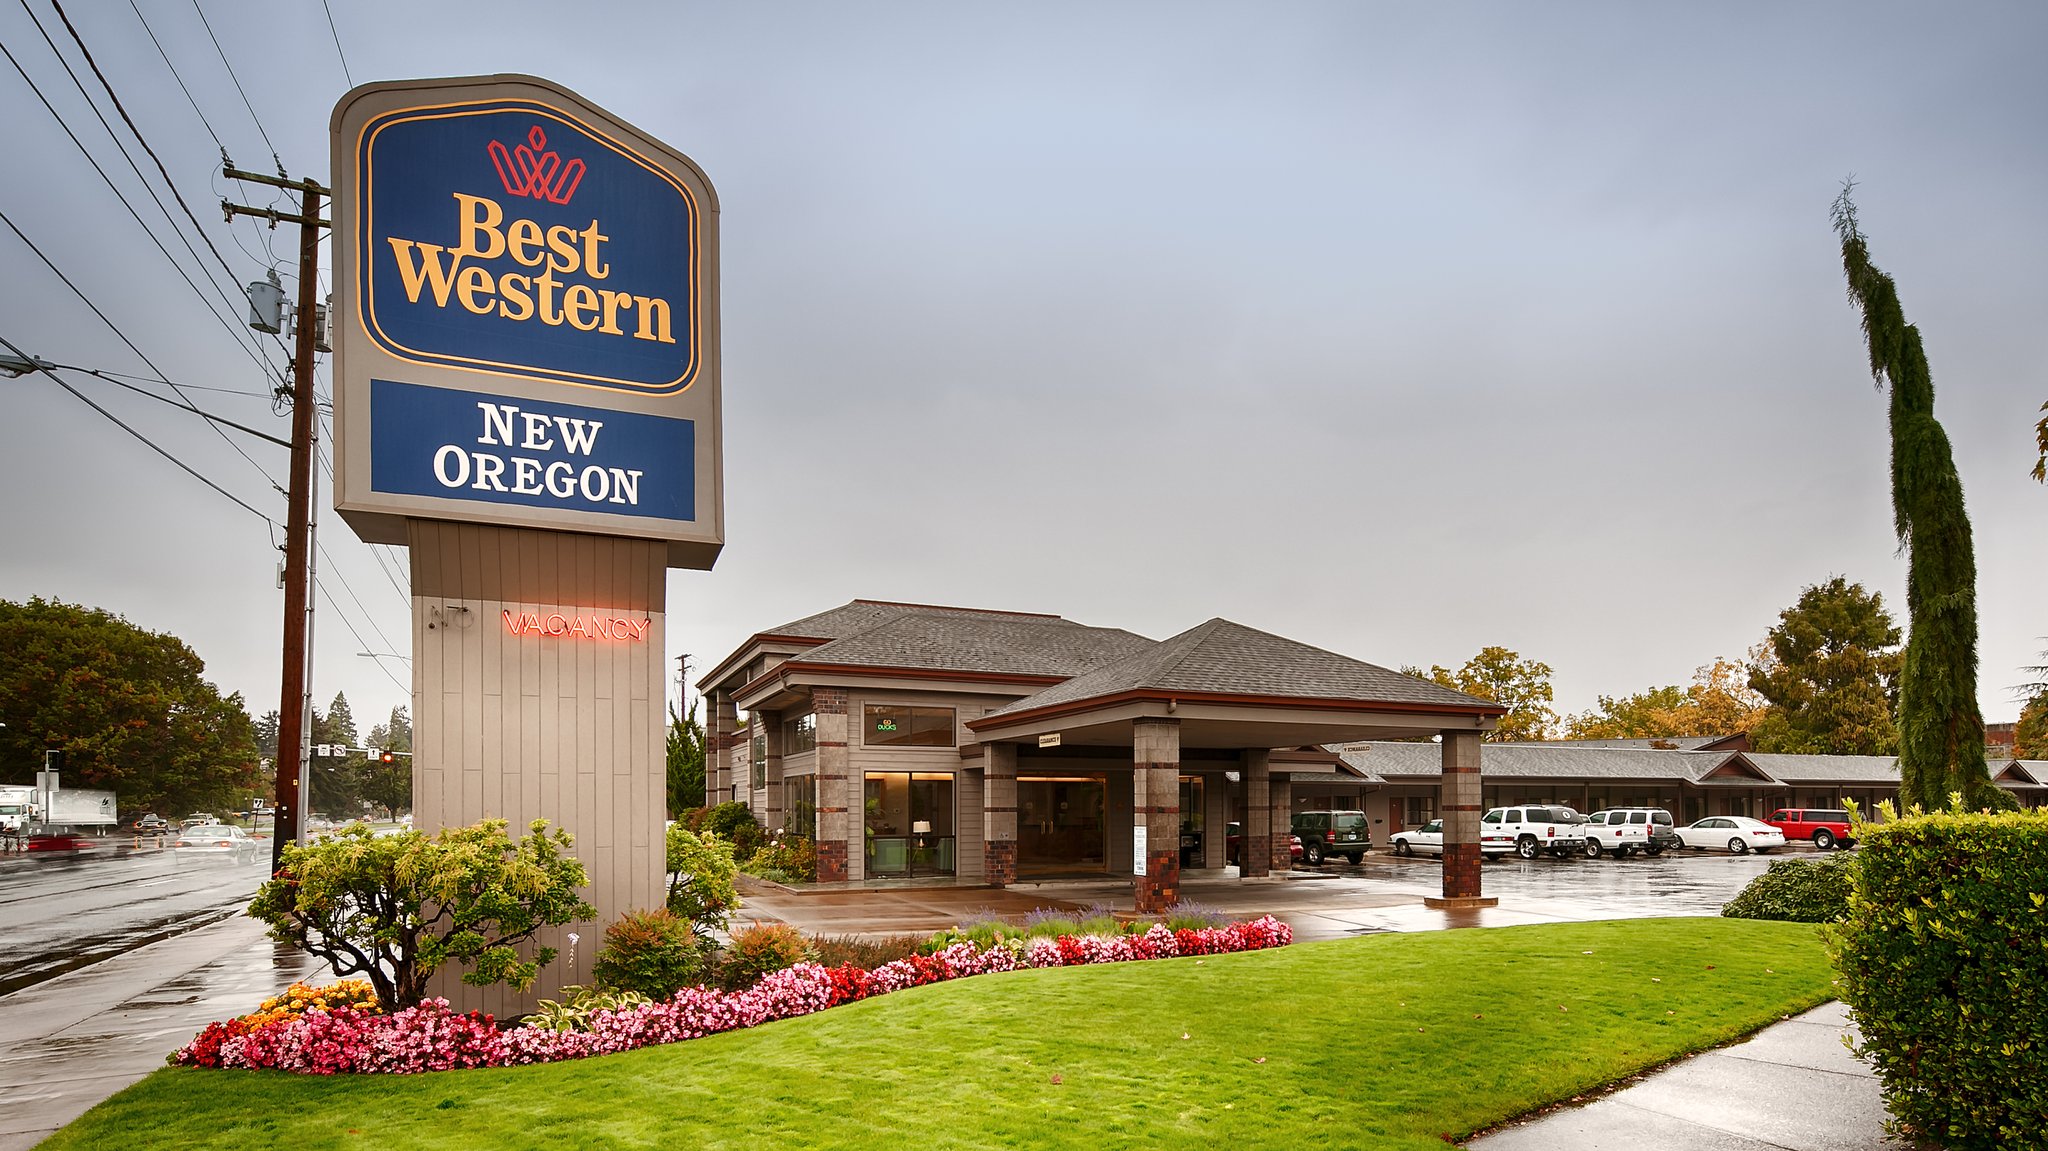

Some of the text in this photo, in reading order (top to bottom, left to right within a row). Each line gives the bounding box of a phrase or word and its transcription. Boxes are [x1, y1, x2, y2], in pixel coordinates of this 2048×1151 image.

[453, 192, 609, 280] Best
[387, 237, 676, 344] Western
[477, 401, 603, 456] NEW
[433, 444, 643, 505] OREGON
[503, 610, 651, 641] VACANCY
